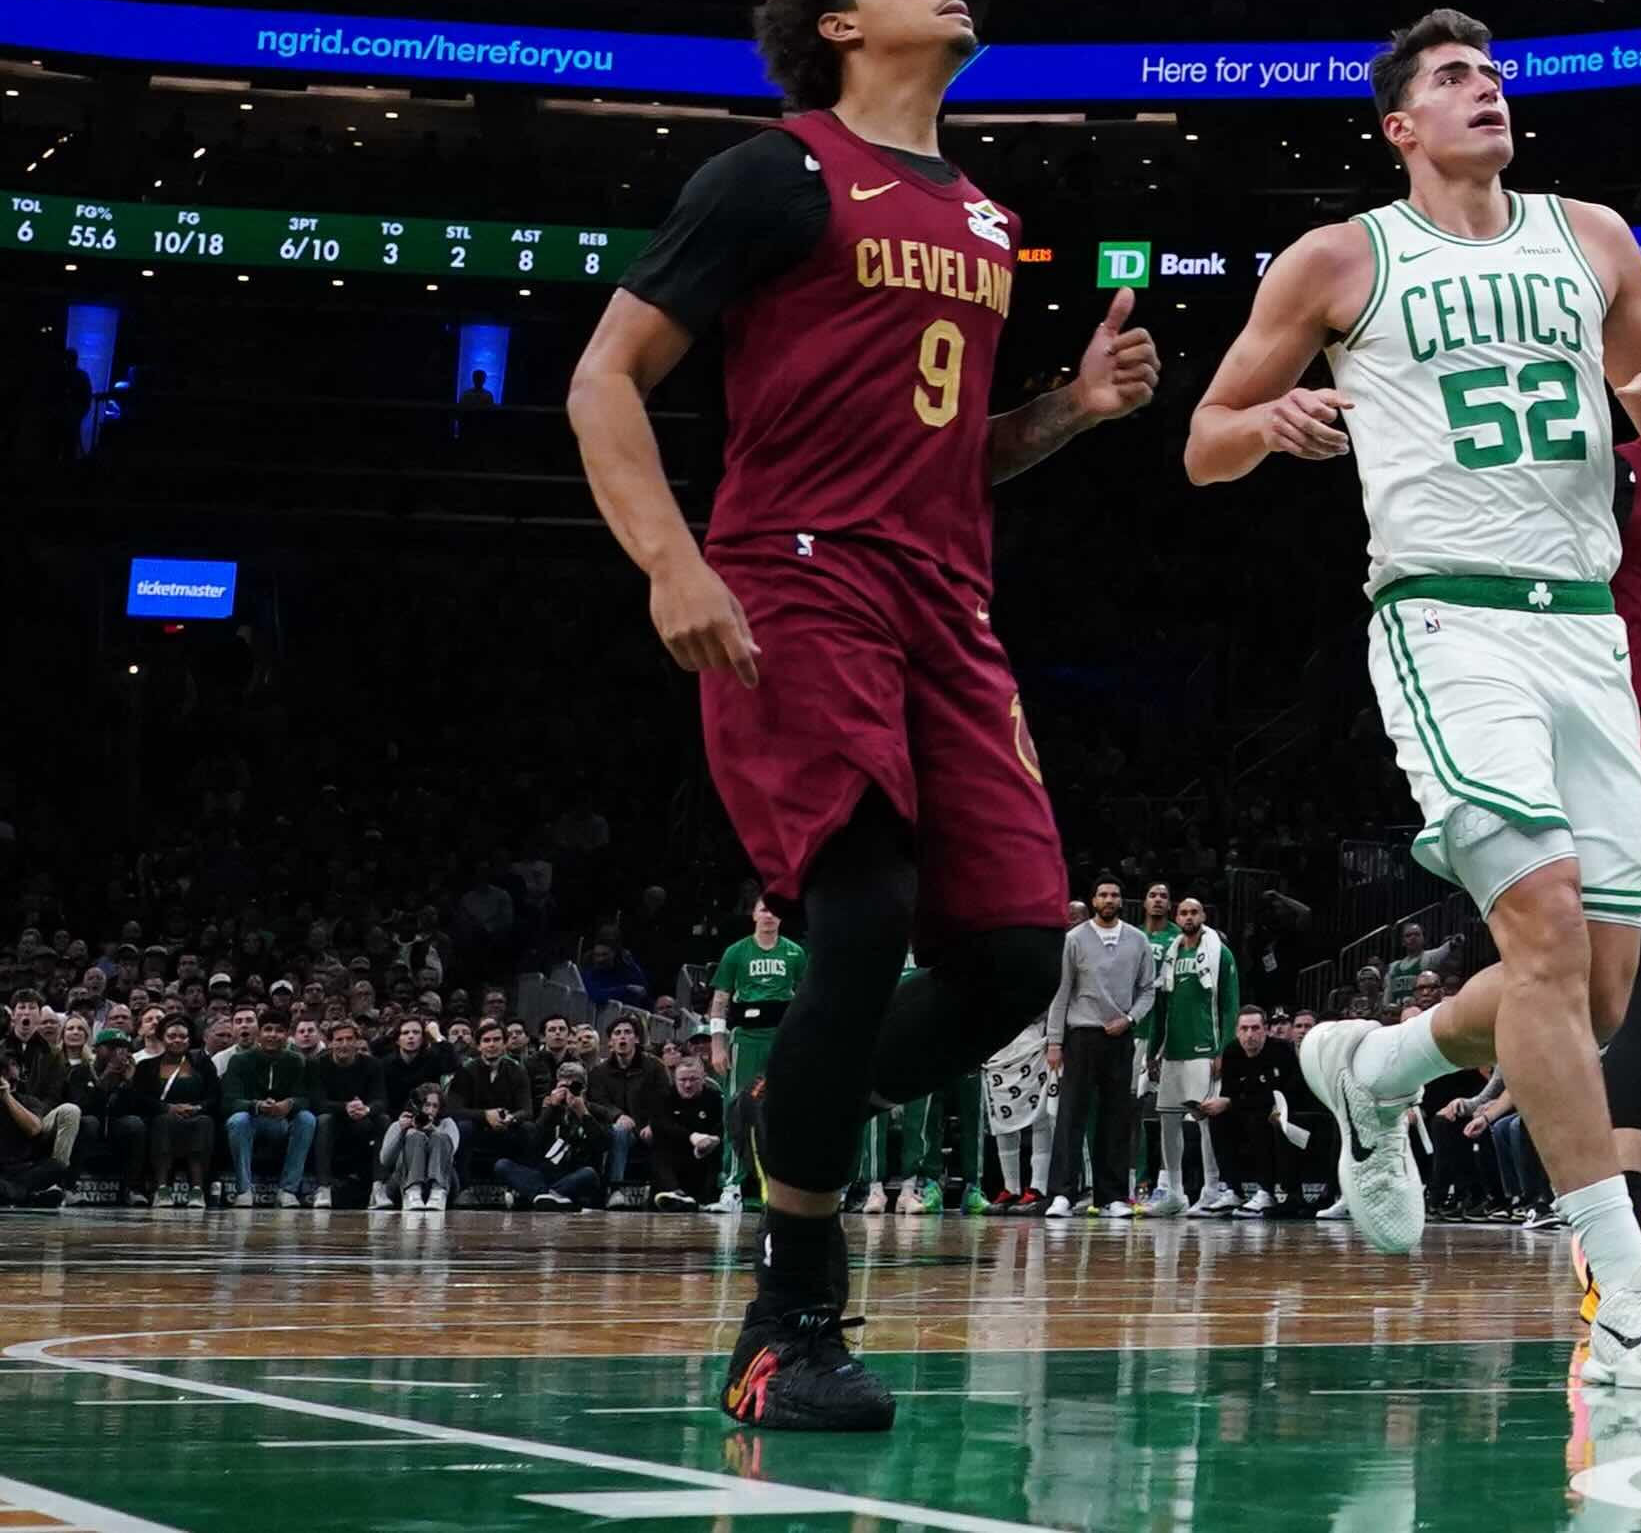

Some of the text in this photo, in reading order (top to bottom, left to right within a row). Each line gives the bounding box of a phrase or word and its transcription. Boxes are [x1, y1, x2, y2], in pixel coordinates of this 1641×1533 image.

[256, 26, 613, 73] ngrid.com/hereforyou
[1142, 56, 1208, 83] Here
[1216, 56, 1252, 82] for
[1259, 61, 1320, 88] your
[1525, 52, 1604, 77] home
[12, 197, 608, 248] TOL FG% FG 3PT TO STL AST REB
[17, 221, 600, 275] 6 55.6 10/18 6/10 3 2 8 8
[1104, 250, 1145, 279] TD
[1160, 252, 1226, 275] Bank
[856, 238, 1013, 319] CLEVELAN
[1400, 272, 1582, 363] CELTICS
[913, 319, 966, 428] 9
[1438, 360, 1587, 471] 52
[136, 580, 227, 598] ticketmaster
[749, 959, 786, 976] CELTICS
